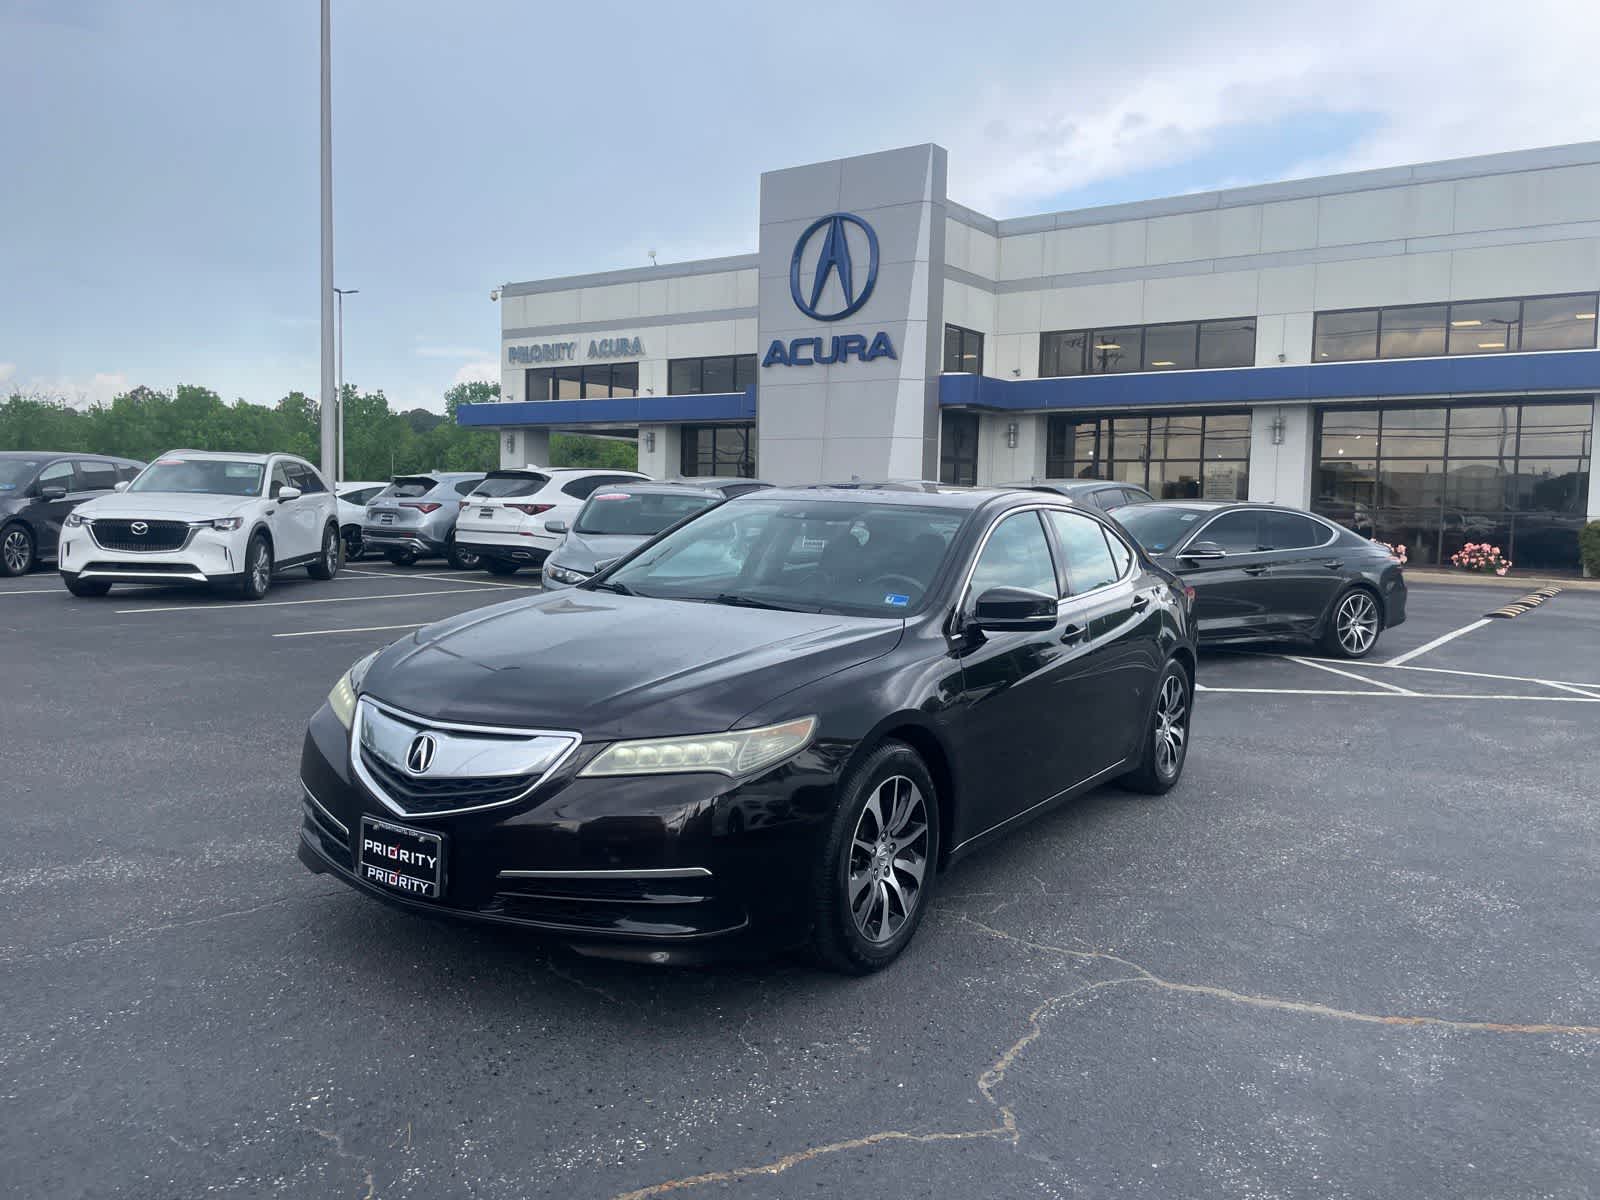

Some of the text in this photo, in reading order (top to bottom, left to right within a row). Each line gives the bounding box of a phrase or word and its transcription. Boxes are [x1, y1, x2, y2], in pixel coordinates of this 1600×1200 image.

[508, 336, 645, 363] PRIORITY ACURA
[761, 331, 898, 367] ACURA
[364, 839, 437, 869] PRIORITY
[367, 867, 428, 894] PRIORITY
